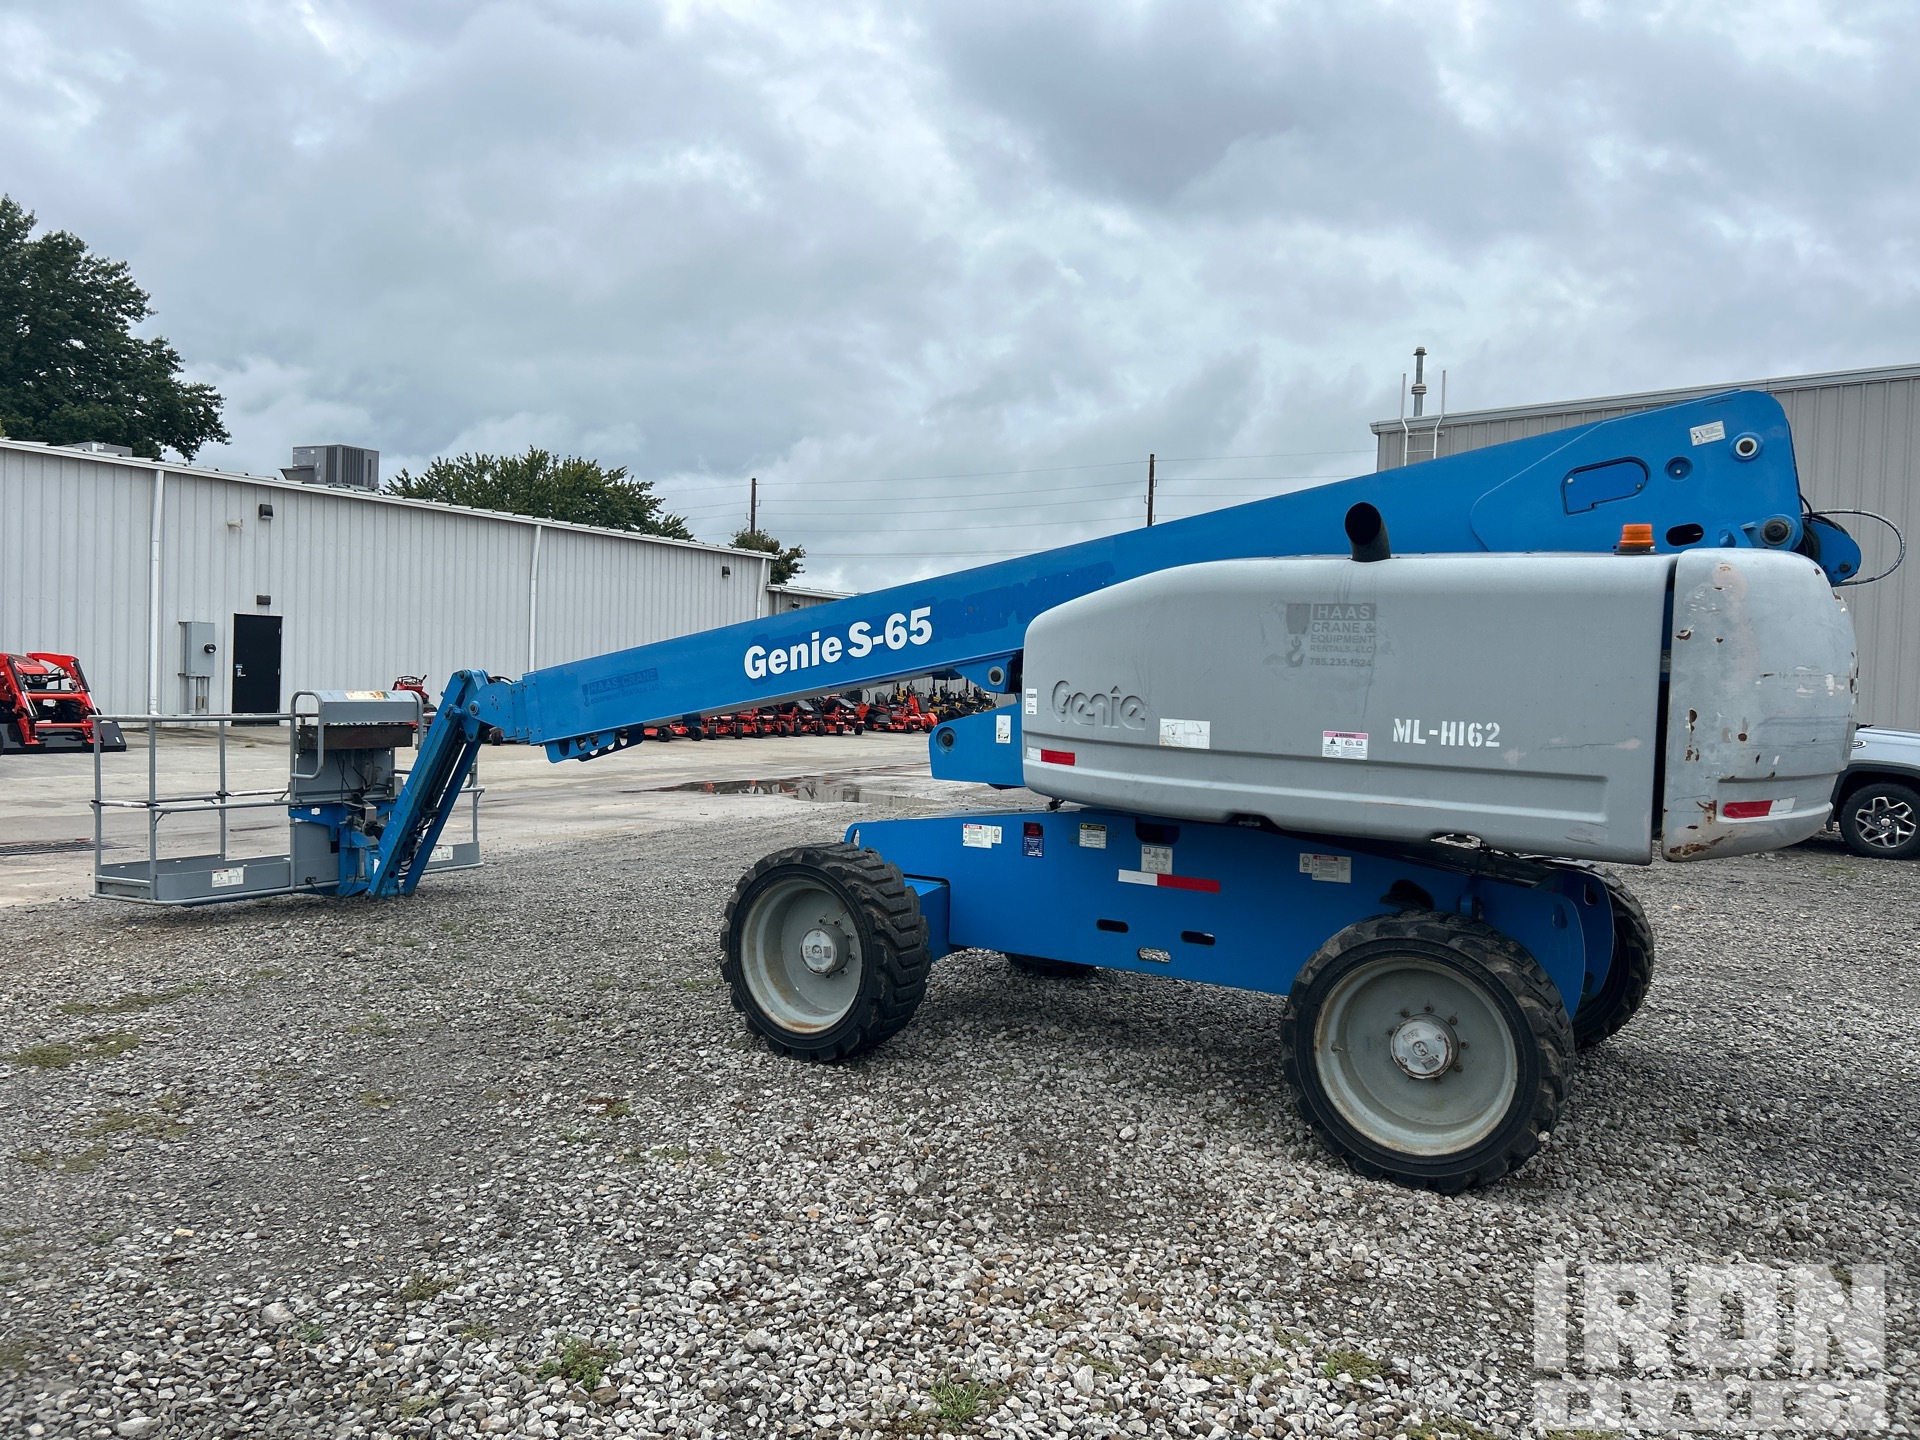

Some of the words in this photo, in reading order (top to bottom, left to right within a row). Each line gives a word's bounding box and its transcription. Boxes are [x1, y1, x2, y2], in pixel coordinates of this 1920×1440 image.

[1317, 605, 1370, 619] HAAS
[1311, 621, 1361, 634] CRANE
[1364, 622, 1375, 633] &
[743, 631, 843, 680] Genie
[847, 606, 933, 658] S-65
[1310, 634, 1376, 644] EQUIPMENT
[1309, 657, 1372, 667] 785.235.1524
[590, 677, 619, 693] HAAS
[621, 669, 658, 687] CRANE
[1051, 680, 1147, 731] Genie
